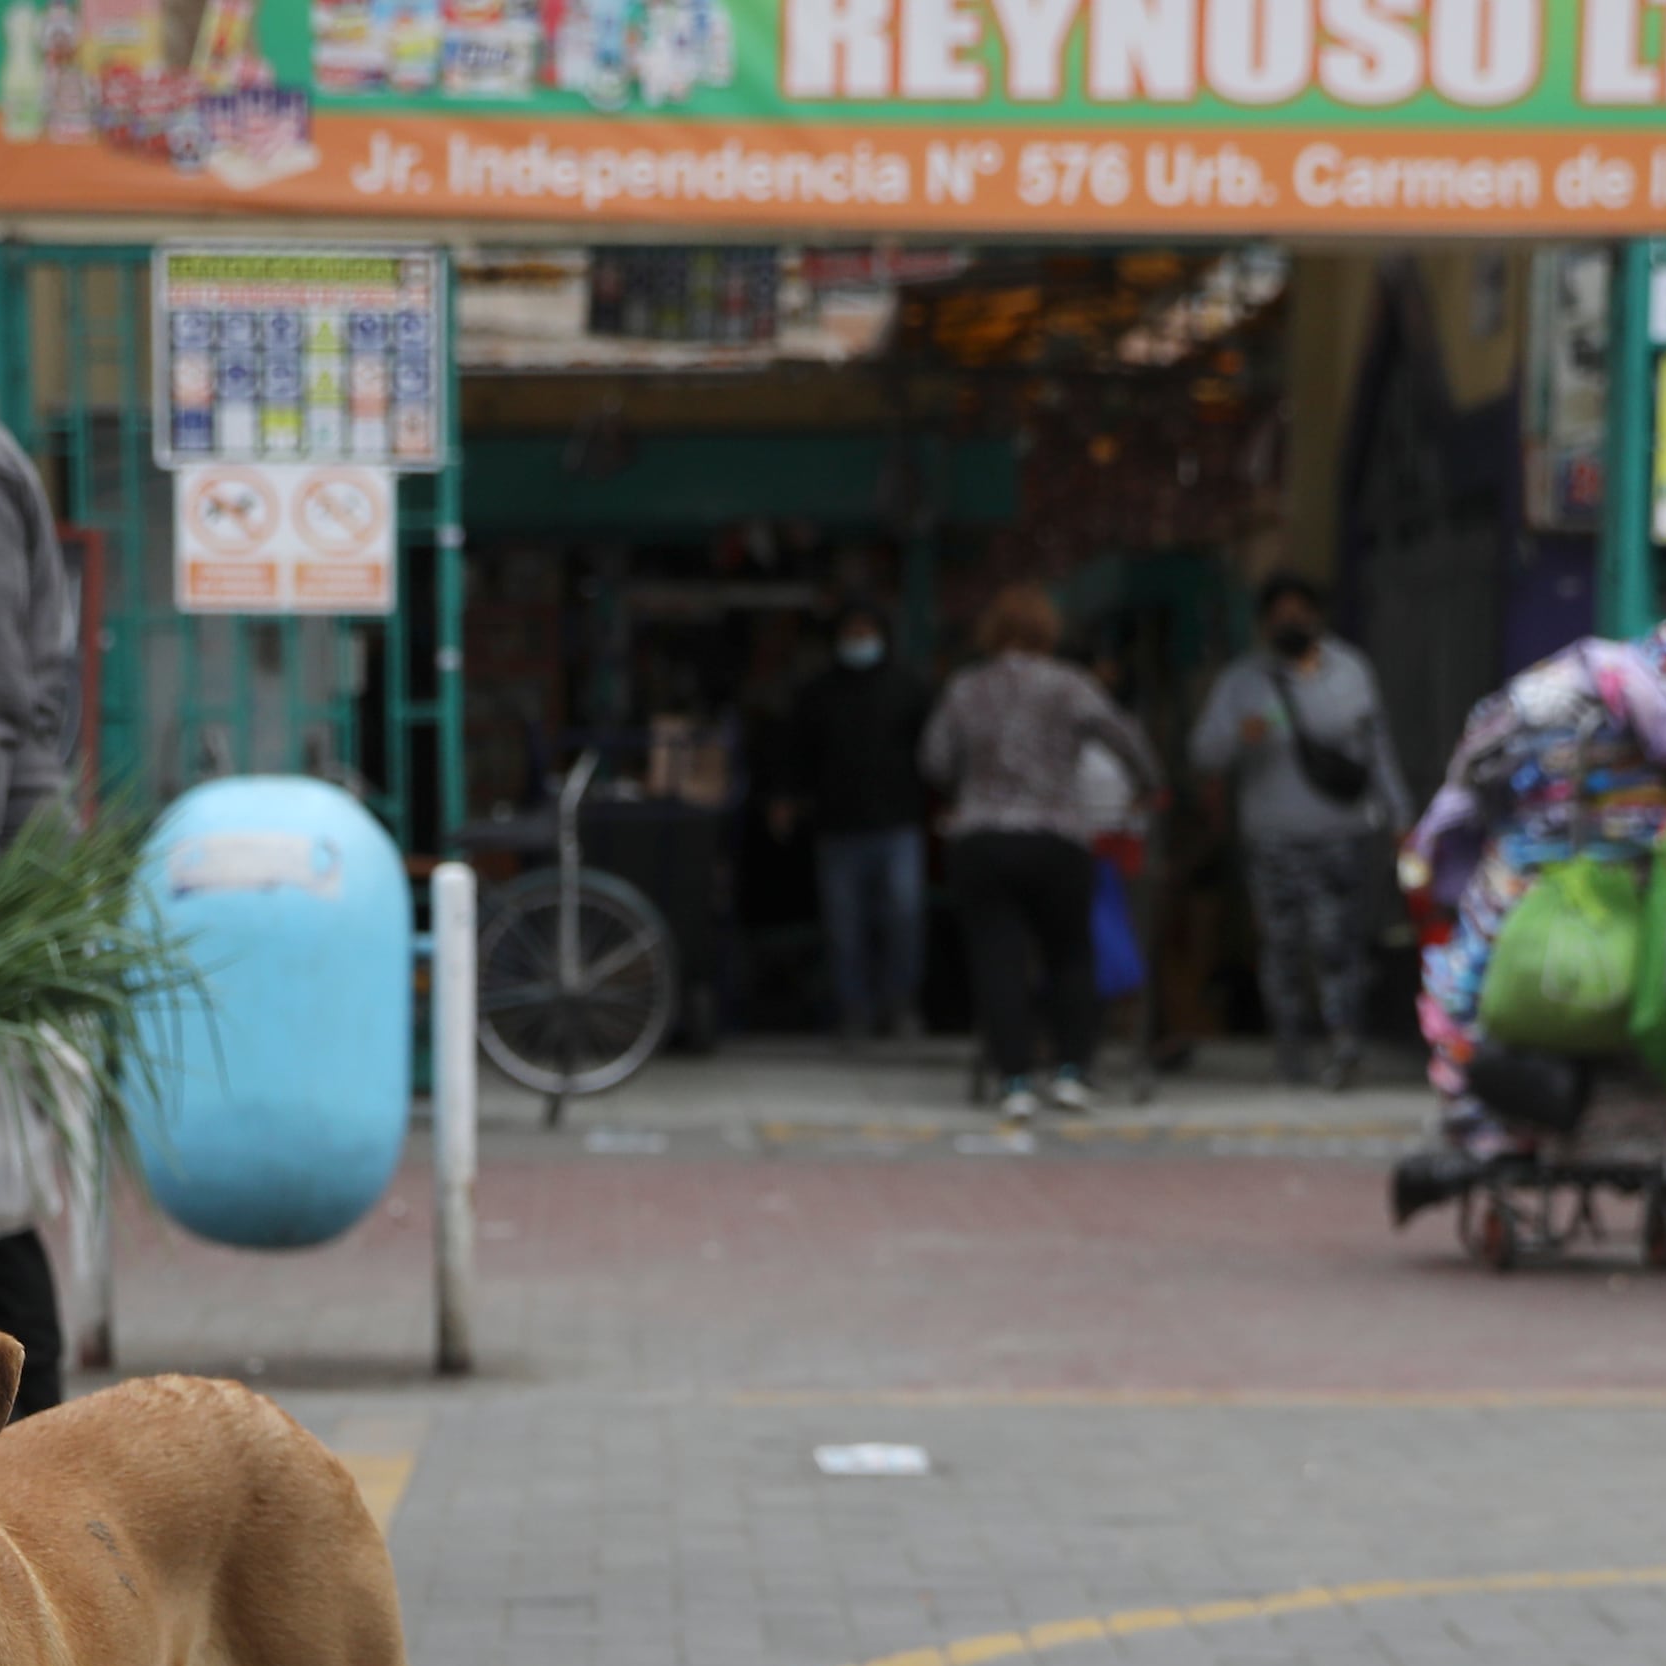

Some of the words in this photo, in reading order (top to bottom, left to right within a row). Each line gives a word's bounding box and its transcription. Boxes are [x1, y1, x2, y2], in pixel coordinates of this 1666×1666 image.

[779, 0, 1543, 107] REYNOSO
[351, 130, 431, 196] Jr.
[446, 132, 911, 211] Independencia
[1017, 142, 1130, 205] 576
[1144, 142, 1278, 207] Urb.
[1292, 142, 1540, 208] Carmen
[1552, 145, 1636, 208] de
